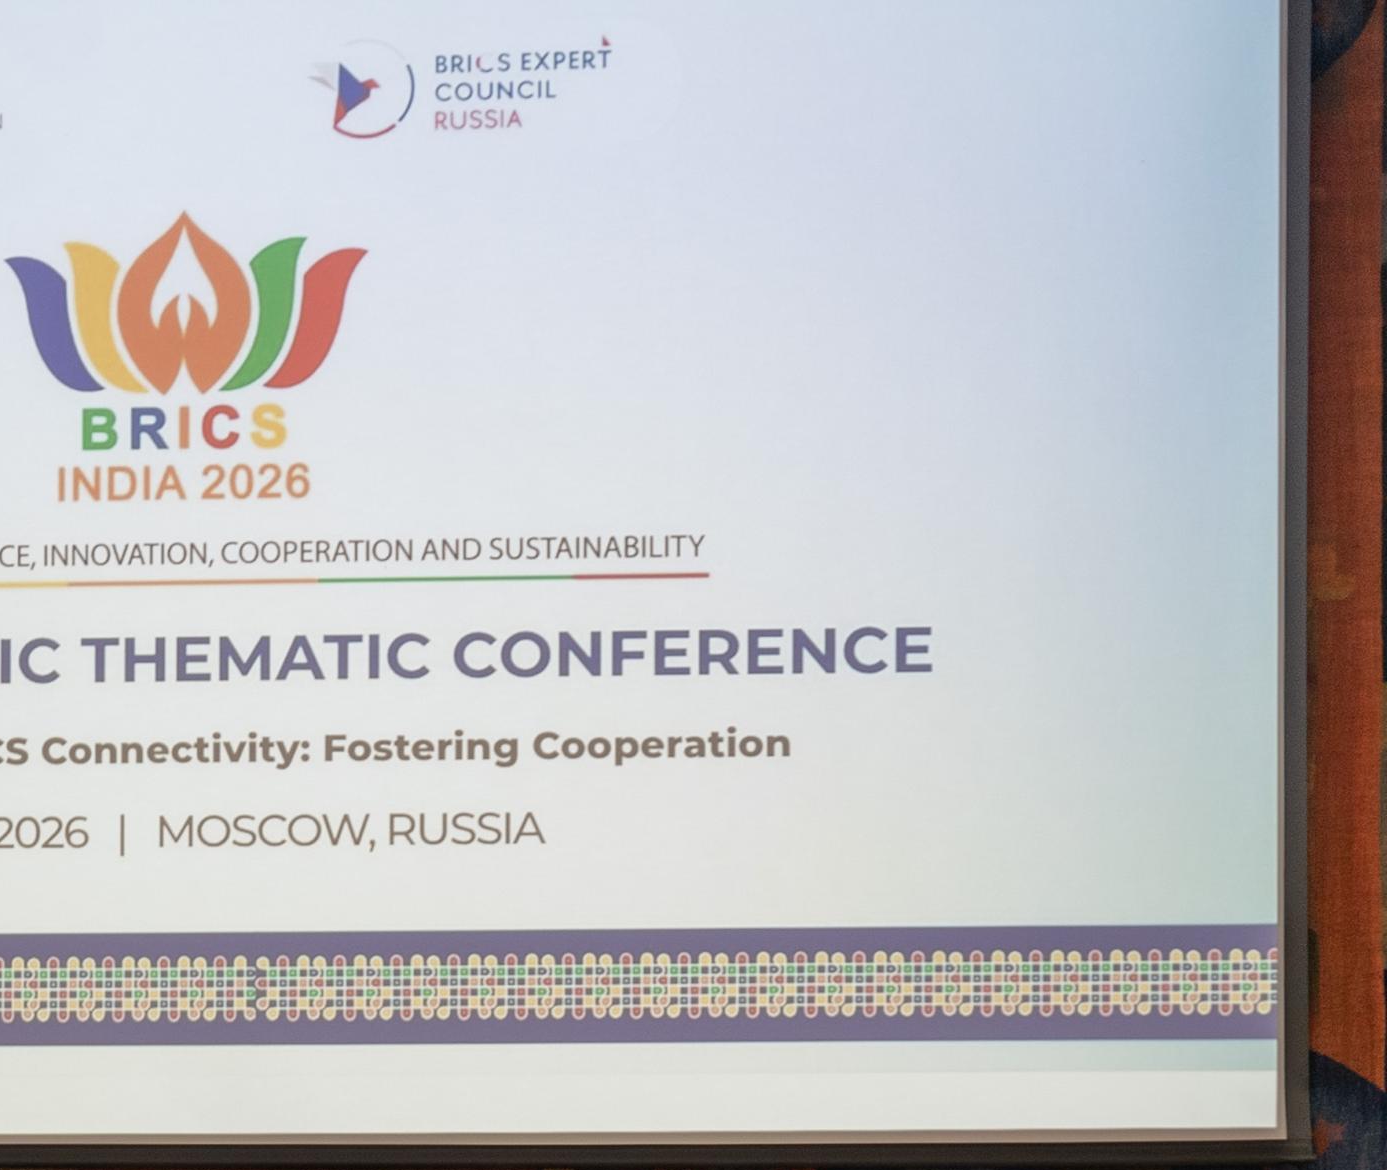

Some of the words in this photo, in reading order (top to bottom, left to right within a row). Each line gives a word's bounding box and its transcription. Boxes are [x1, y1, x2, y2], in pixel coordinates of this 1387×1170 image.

[435, 53, 512, 74] BRICS
[521, 50, 612, 72] EXPERT
[435, 80, 557, 102] COUNCIL
[435, 109, 523, 130] RUSSIA
[81, 403, 289, 453] BRICS
[57, 465, 188, 504] INDIA
[201, 462, 312, 502] 2026
[44, 541, 215, 572] INNOVATION,
[221, 539, 415, 566] COOPERATION
[421, 538, 483, 562] AND
[490, 534, 706, 561] SUSTAINABILITY
[81, 632, 431, 685] THEMATIC
[454, 626, 934, 681] CONFERENCE
[42, 732, 311, 772] Connectivity:
[325, 730, 520, 769] Fostering
[533, 726, 792, 768] Cooperation
[159, 814, 377, 854] MOSCOW,
[388, 812, 547, 847] RUSSIA
